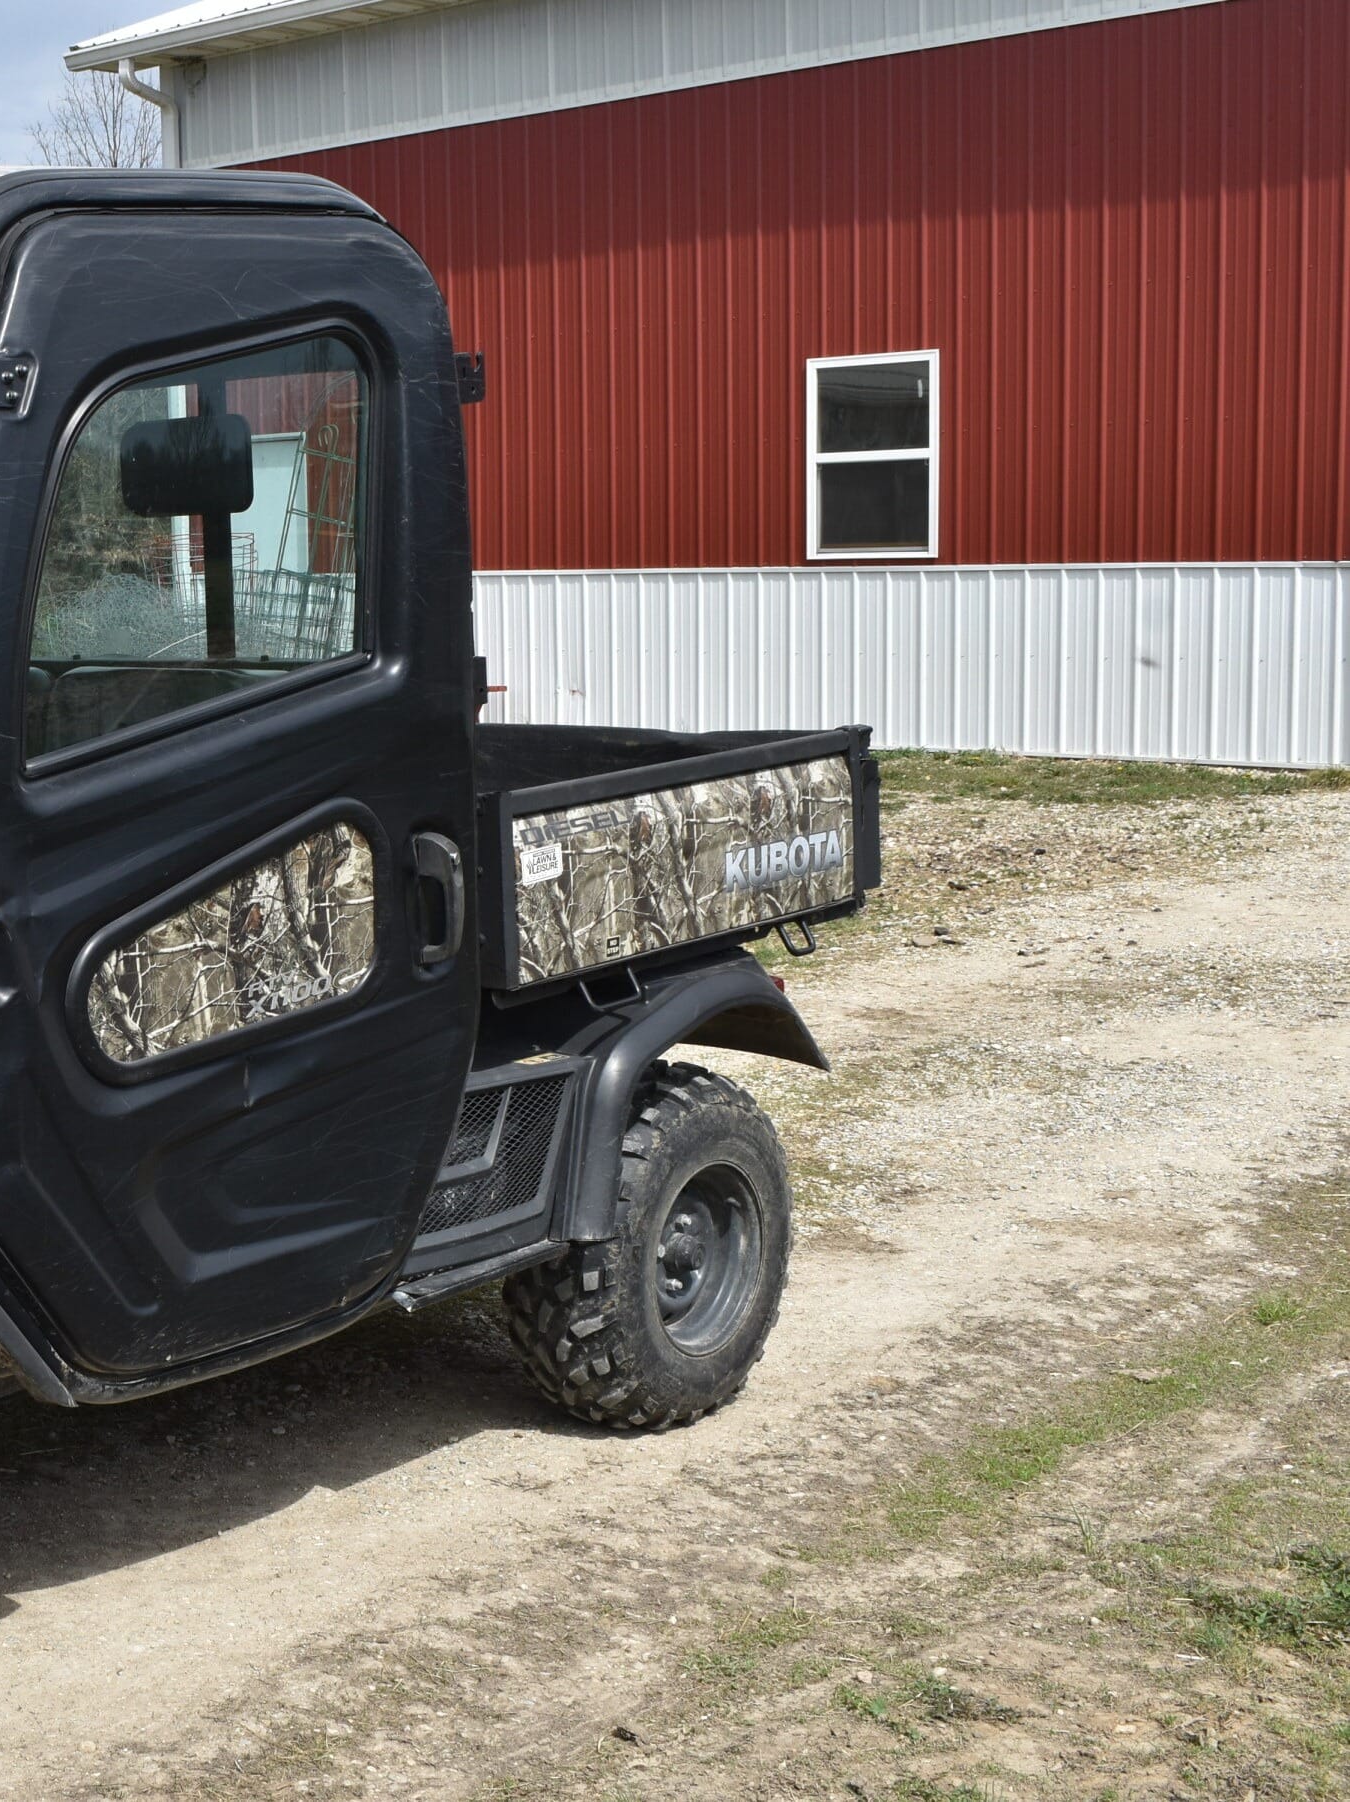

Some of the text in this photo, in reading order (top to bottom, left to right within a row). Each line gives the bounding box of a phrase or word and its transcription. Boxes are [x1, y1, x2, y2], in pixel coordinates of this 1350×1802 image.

[520, 810, 630, 845] DIESEL
[532, 860, 559, 875] LEISURE
[725, 829, 844, 893] KUBOTA
[607, 946, 619, 955] STEP
[245, 975, 332, 1019] X1100
[248, 969, 296, 998] RTV
